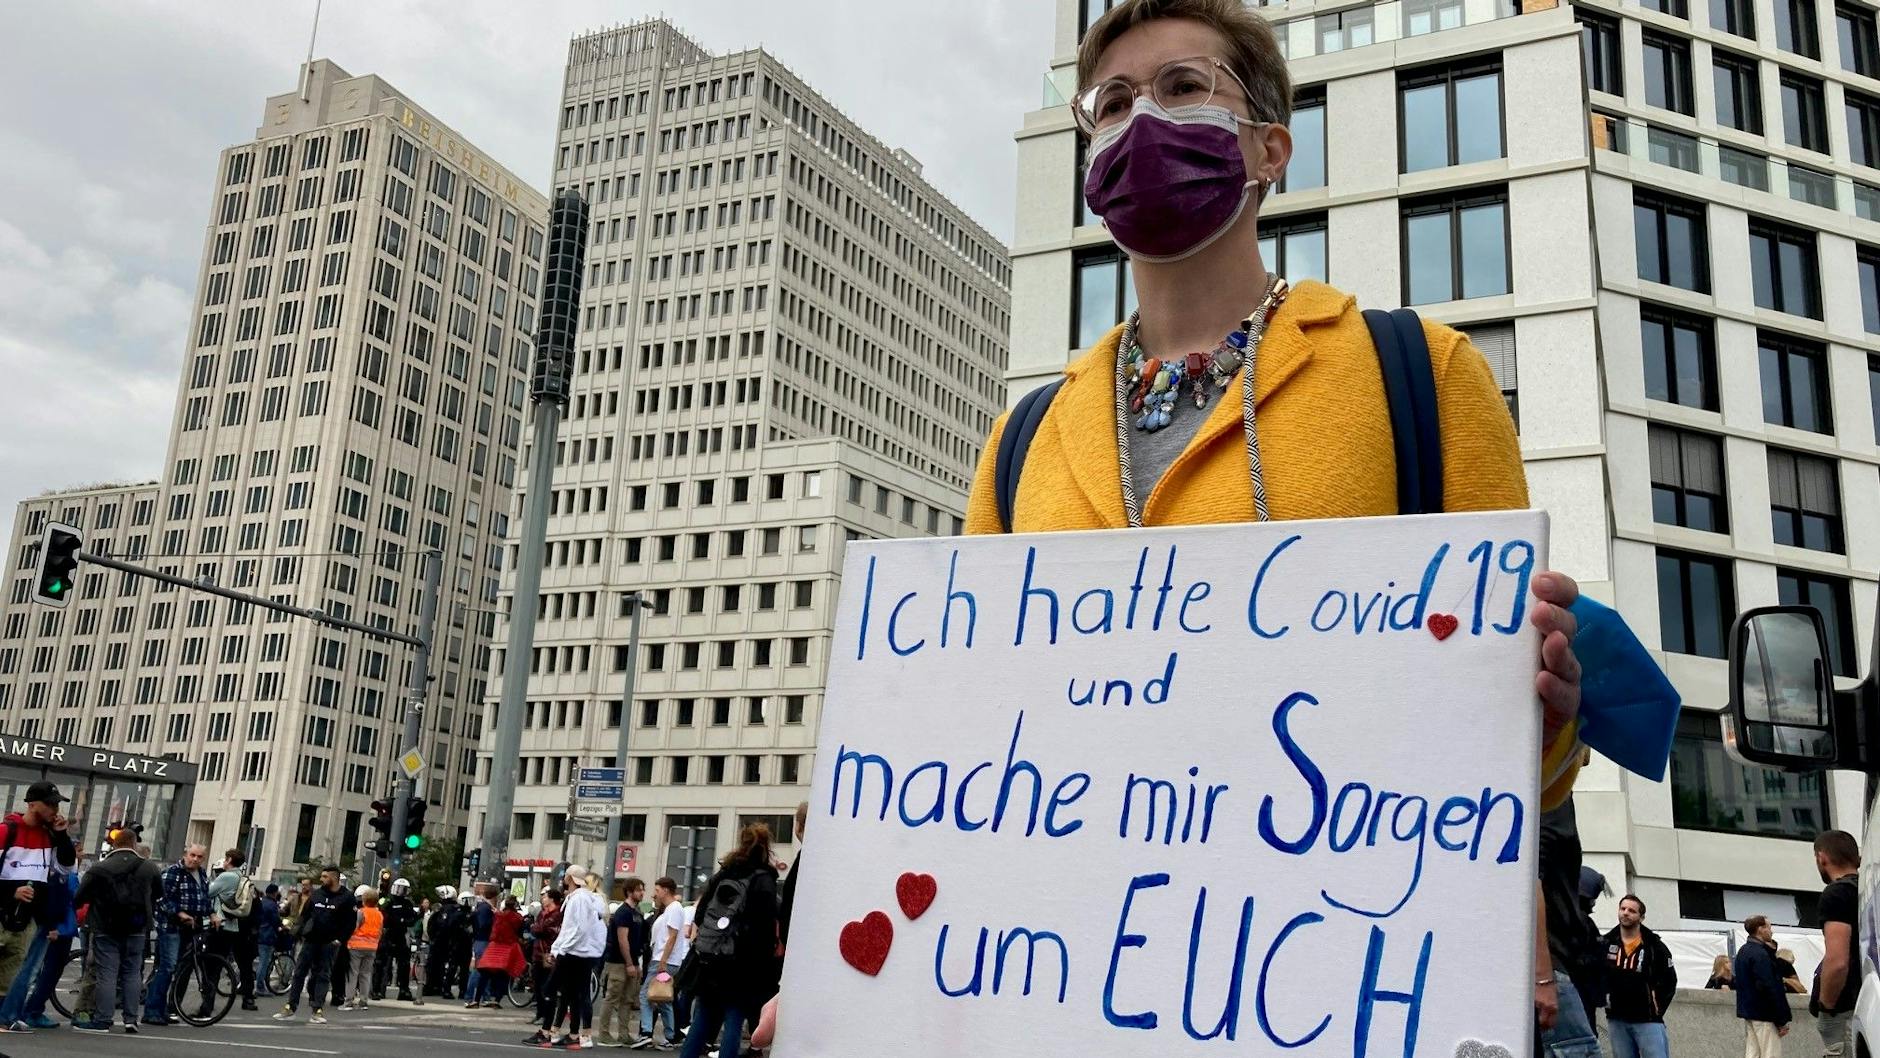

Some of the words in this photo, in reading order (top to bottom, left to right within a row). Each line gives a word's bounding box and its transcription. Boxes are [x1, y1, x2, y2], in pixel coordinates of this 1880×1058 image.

[402, 105, 518, 202] BEISHEIM
[857, 549, 976, 660] Ich
[1013, 545, 1212, 647] hatte
[1247, 535, 1452, 641] Covid
[1070, 650, 1179, 708] und
[92, 753, 168, 776] PLATZ
[580, 804, 603, 813] Leipziger
[829, 710, 1092, 839] mache
[1119, 766, 1230, 845] mir
[1257, 691, 1525, 920] Sorgen
[934, 924, 1070, 1003] um
[1101, 871, 1436, 1058] EUCH
